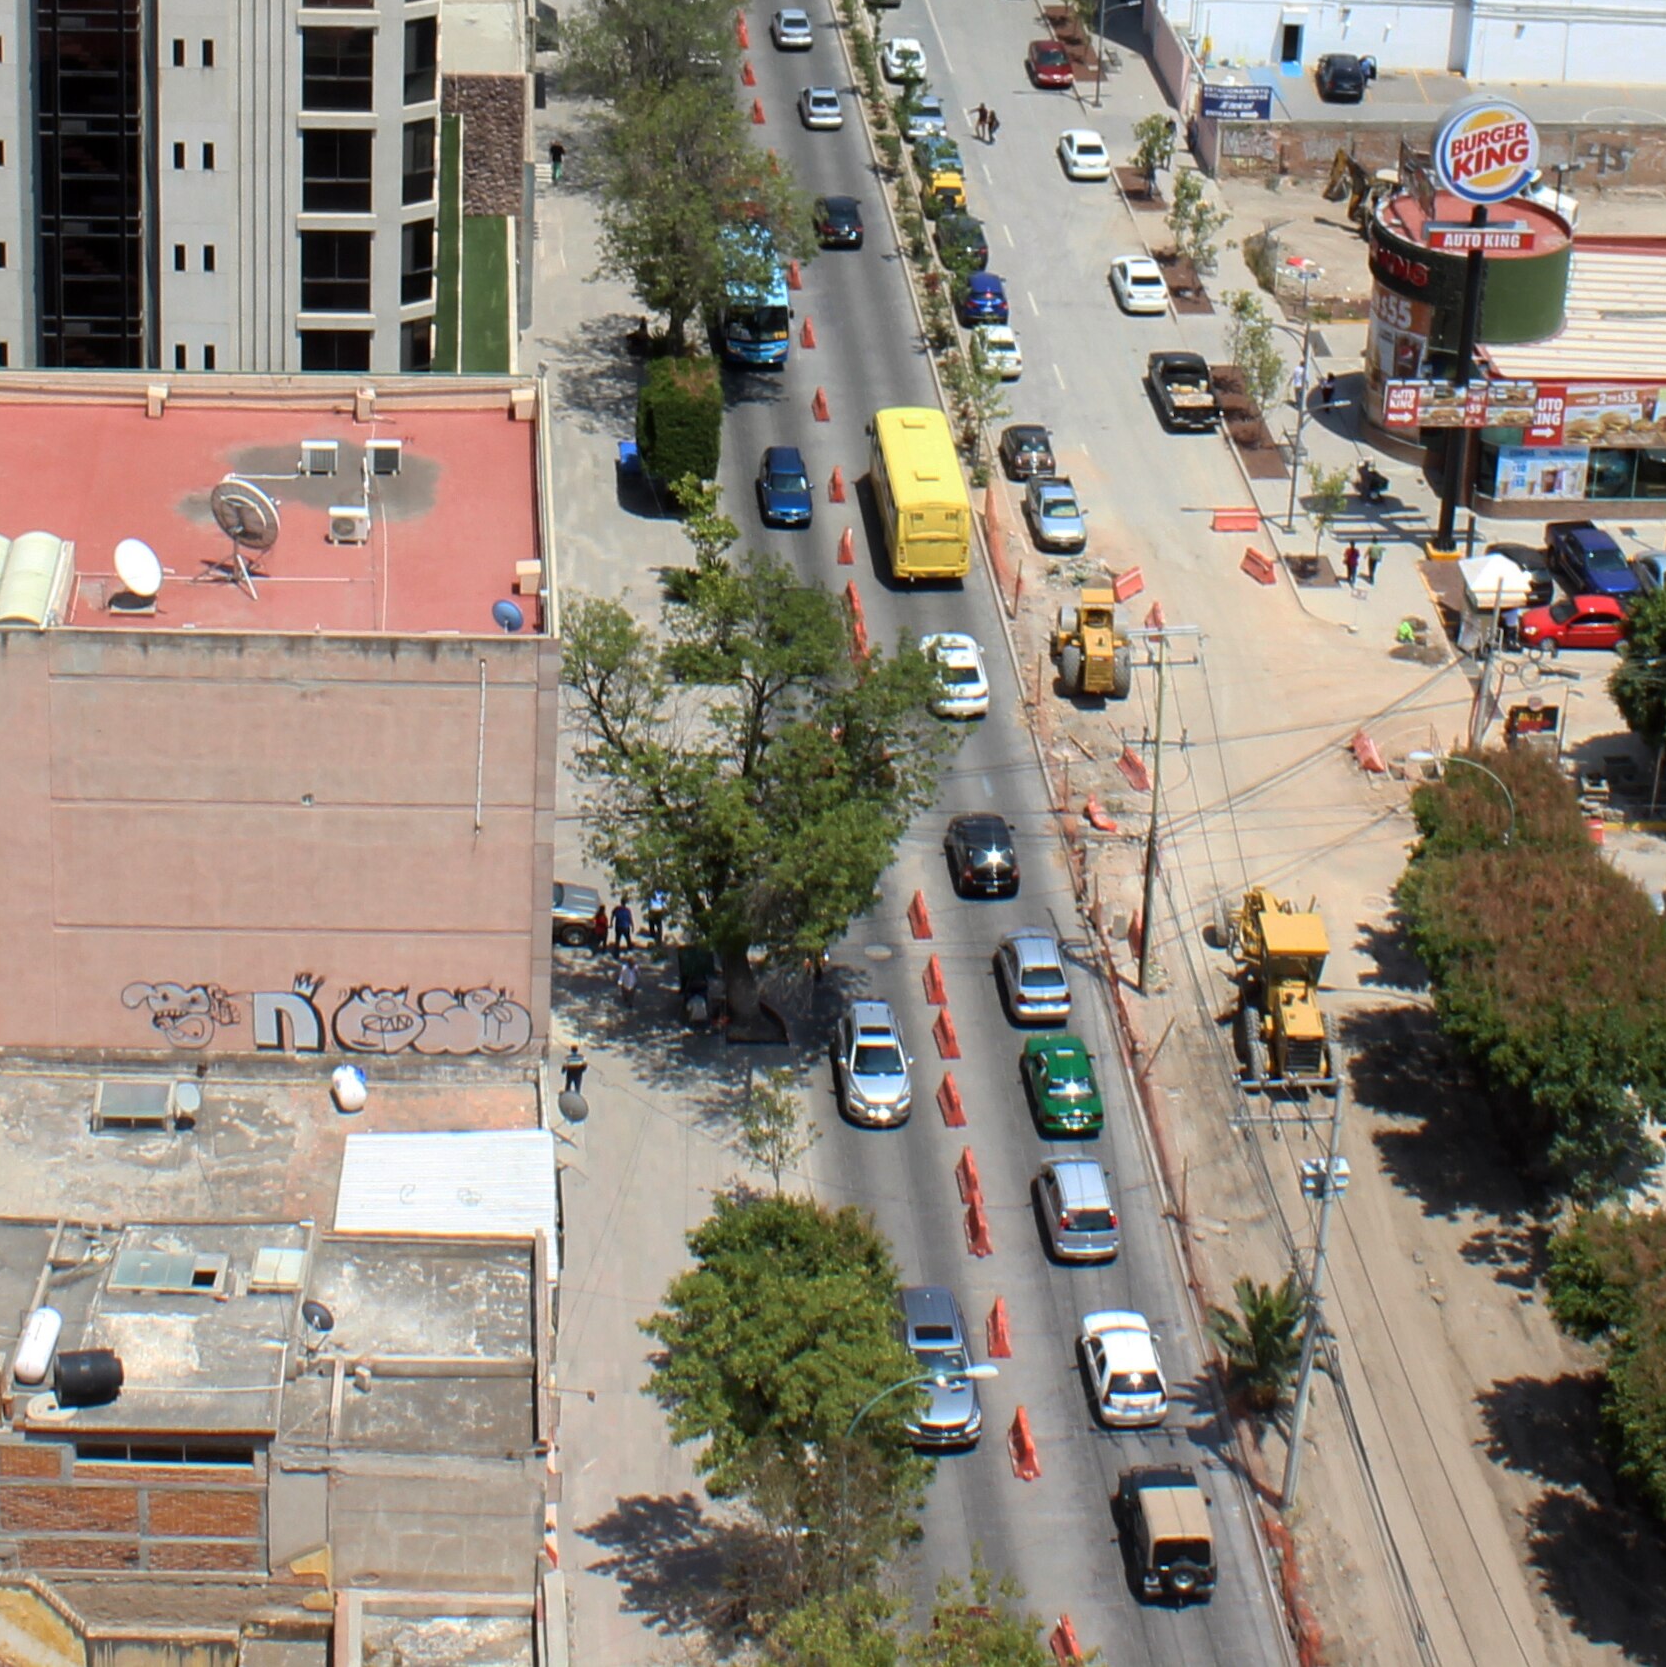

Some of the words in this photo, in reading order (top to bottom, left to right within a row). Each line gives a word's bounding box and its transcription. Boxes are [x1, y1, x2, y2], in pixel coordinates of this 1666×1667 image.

[1450, 122, 1528, 159] BURGER
[1452, 139, 1529, 182] KING
[1443, 234, 1481, 248] AUTO
[1484, 234, 1520, 249] KING
[1390, 388, 1416, 400] AUTO
[1389, 398, 1415, 410] KING
[1534, 398, 1564, 412] UTO
[1533, 413, 1562, 426] ING
